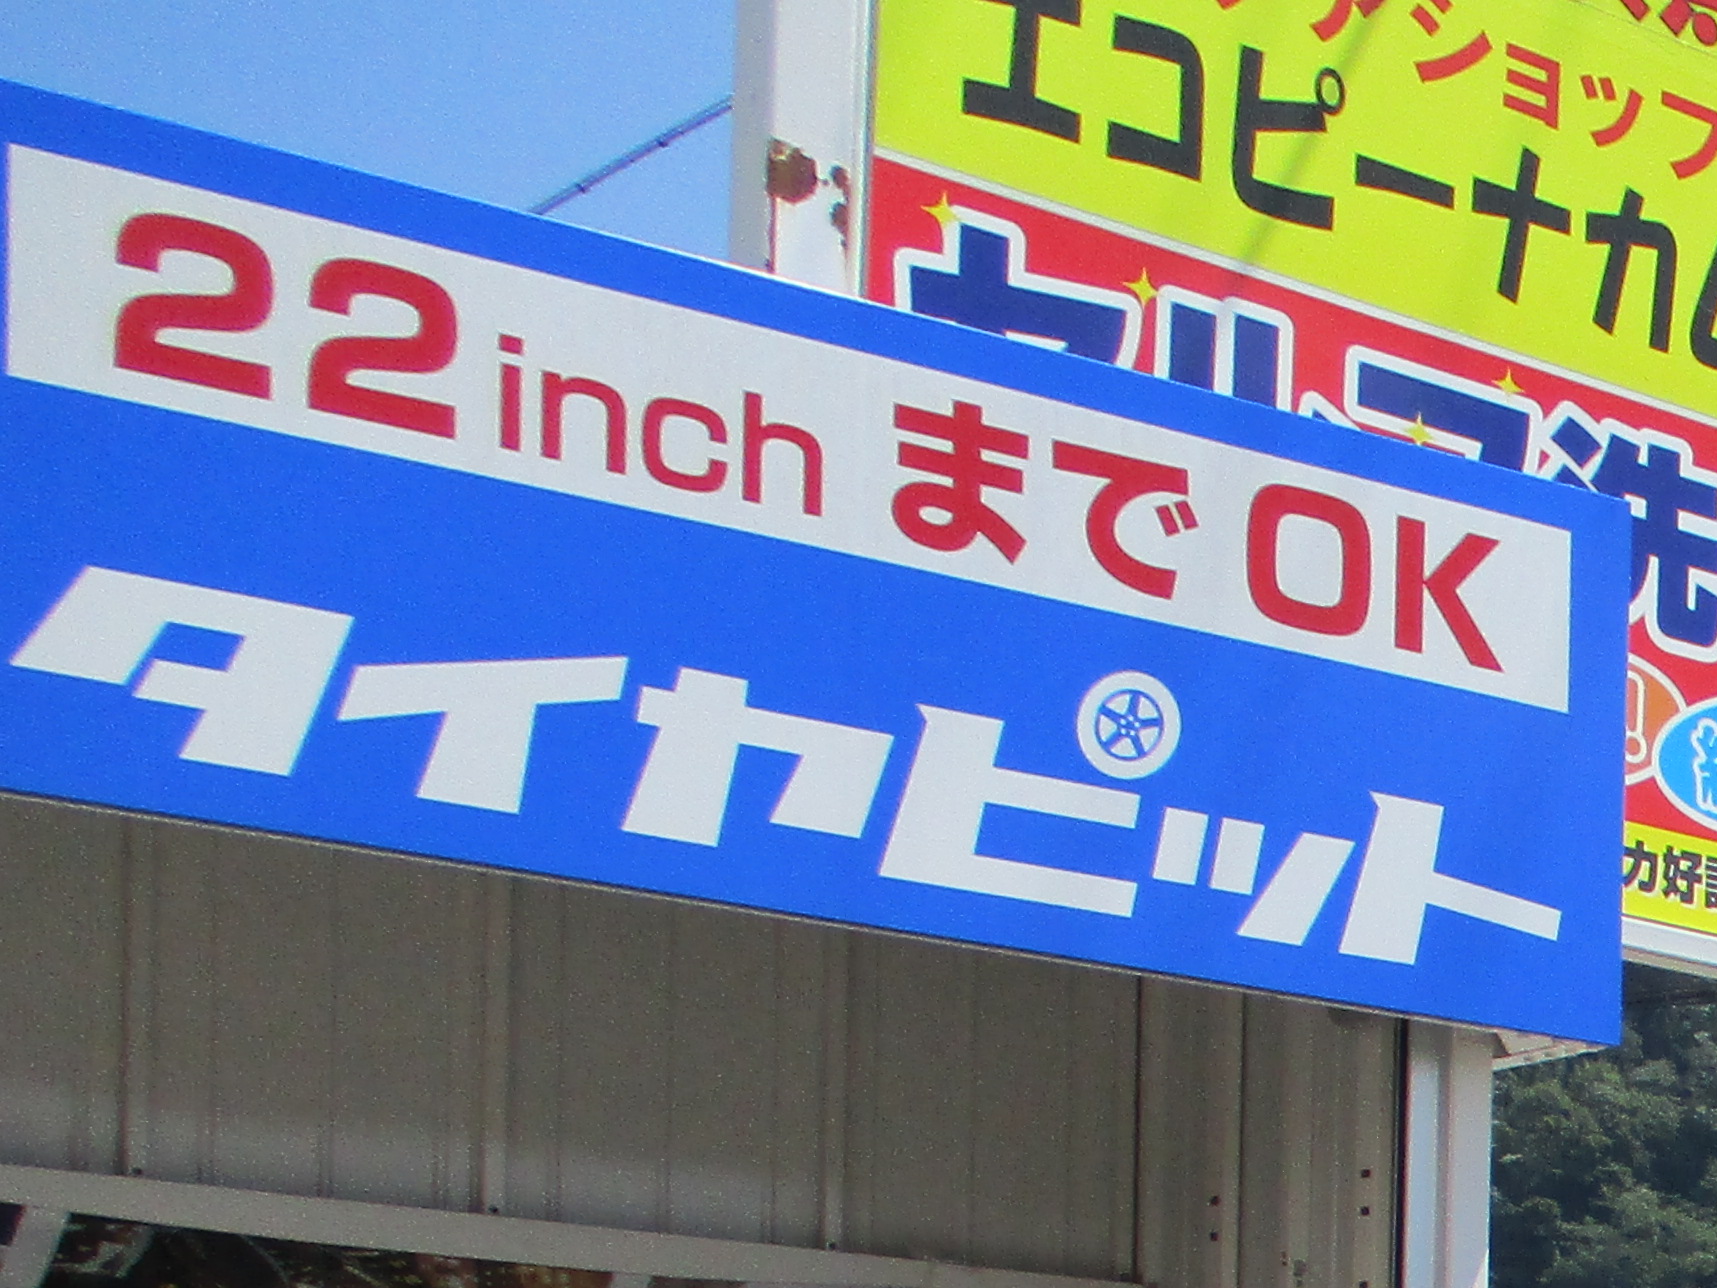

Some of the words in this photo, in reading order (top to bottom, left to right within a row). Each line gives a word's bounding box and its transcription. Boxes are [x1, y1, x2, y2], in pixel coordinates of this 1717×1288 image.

[10, 565, 1562, 966] タイヤピット
